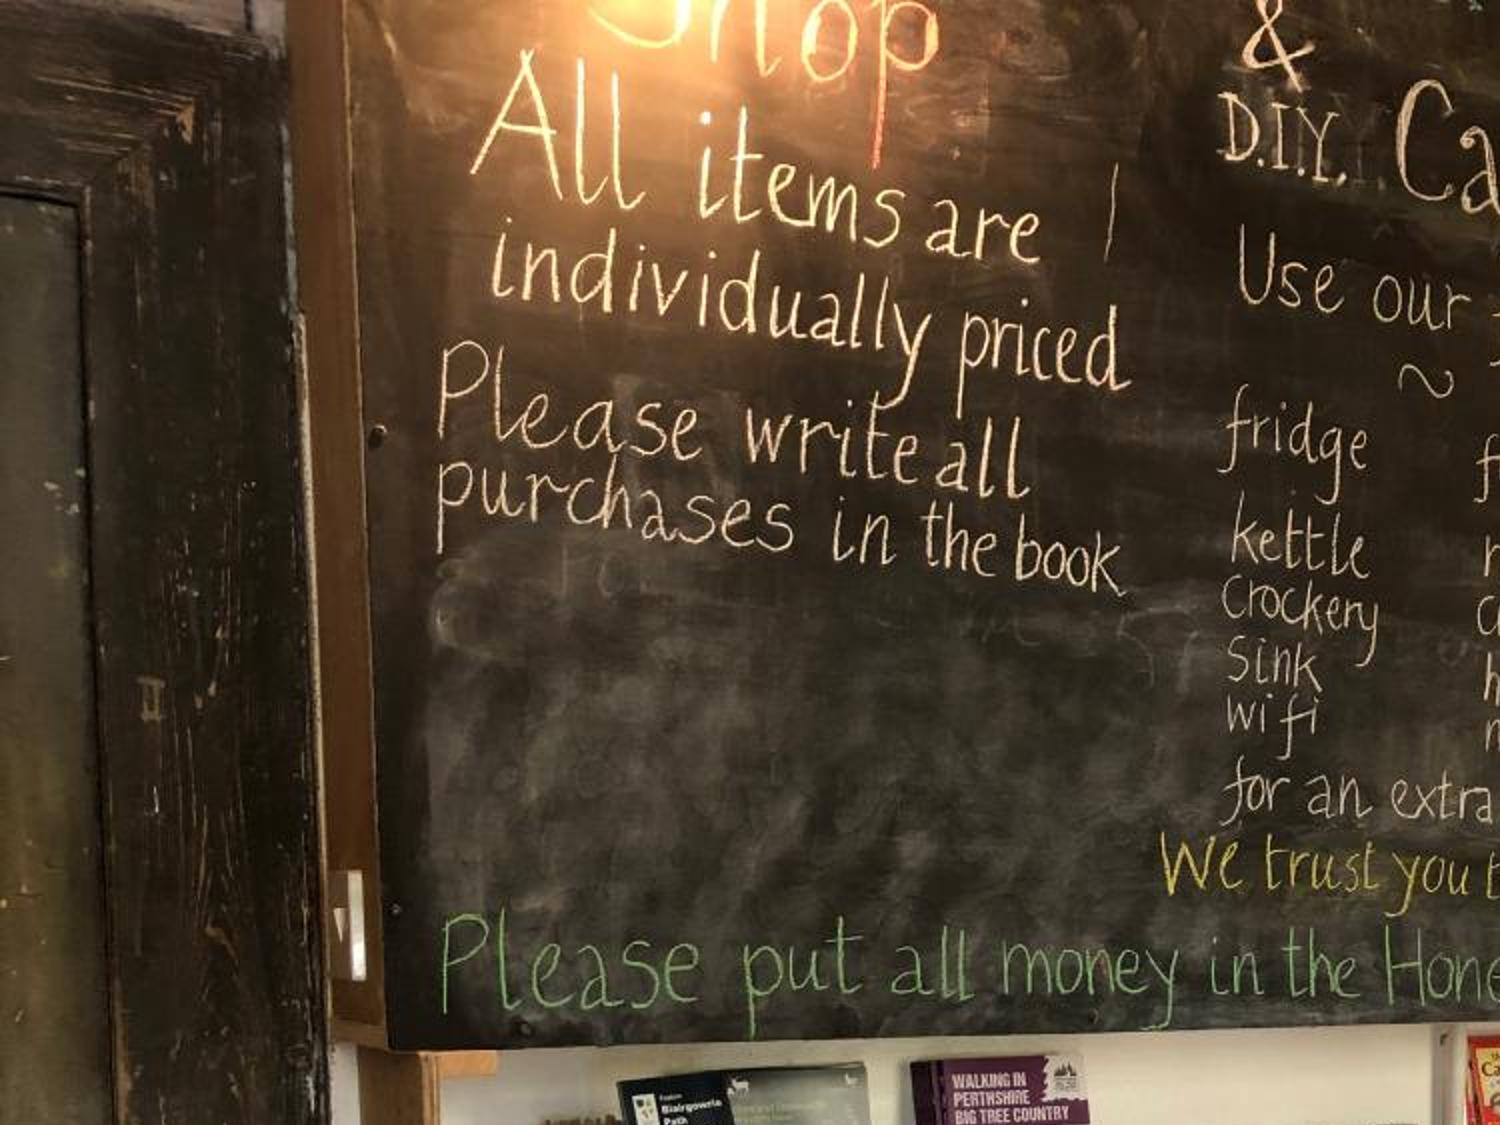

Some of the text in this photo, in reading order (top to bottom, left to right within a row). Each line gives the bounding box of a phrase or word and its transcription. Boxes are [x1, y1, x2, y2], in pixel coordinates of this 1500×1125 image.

[469, 48, 1042, 264] All items are
[492, 215, 1133, 420] individually priced
[1238, 222, 1345, 317] Use
[1373, 272, 1473, 334] our
[438, 339, 1032, 501] Please write all
[1217, 382, 1369, 506] fridge
[434, 458, 1130, 599] purchases in the book
[1230, 491, 1371, 580] kettle
[1219, 754, 1291, 828] for
[1305, 775, 1375, 821] an
[1390, 768, 1494, 825] extra
[1159, 830, 1244, 897] We
[1265, 832, 1382, 894] trust
[1384, 848, 1470, 919] you
[440, 905, 702, 1016] Please
[743, 915, 865, 1040] put
[889, 924, 977, 1001] all
[1001, 936, 1182, 1033] money
[1209, 935, 1265, 998] in
[1281, 925, 1361, 1000] the
[952, 1071, 1027, 1089] WALKING IN
[953, 1090, 1031, 1108] PERTHSHIRE
[955, 1105, 1070, 1125] BIG TREE COUNTRY
